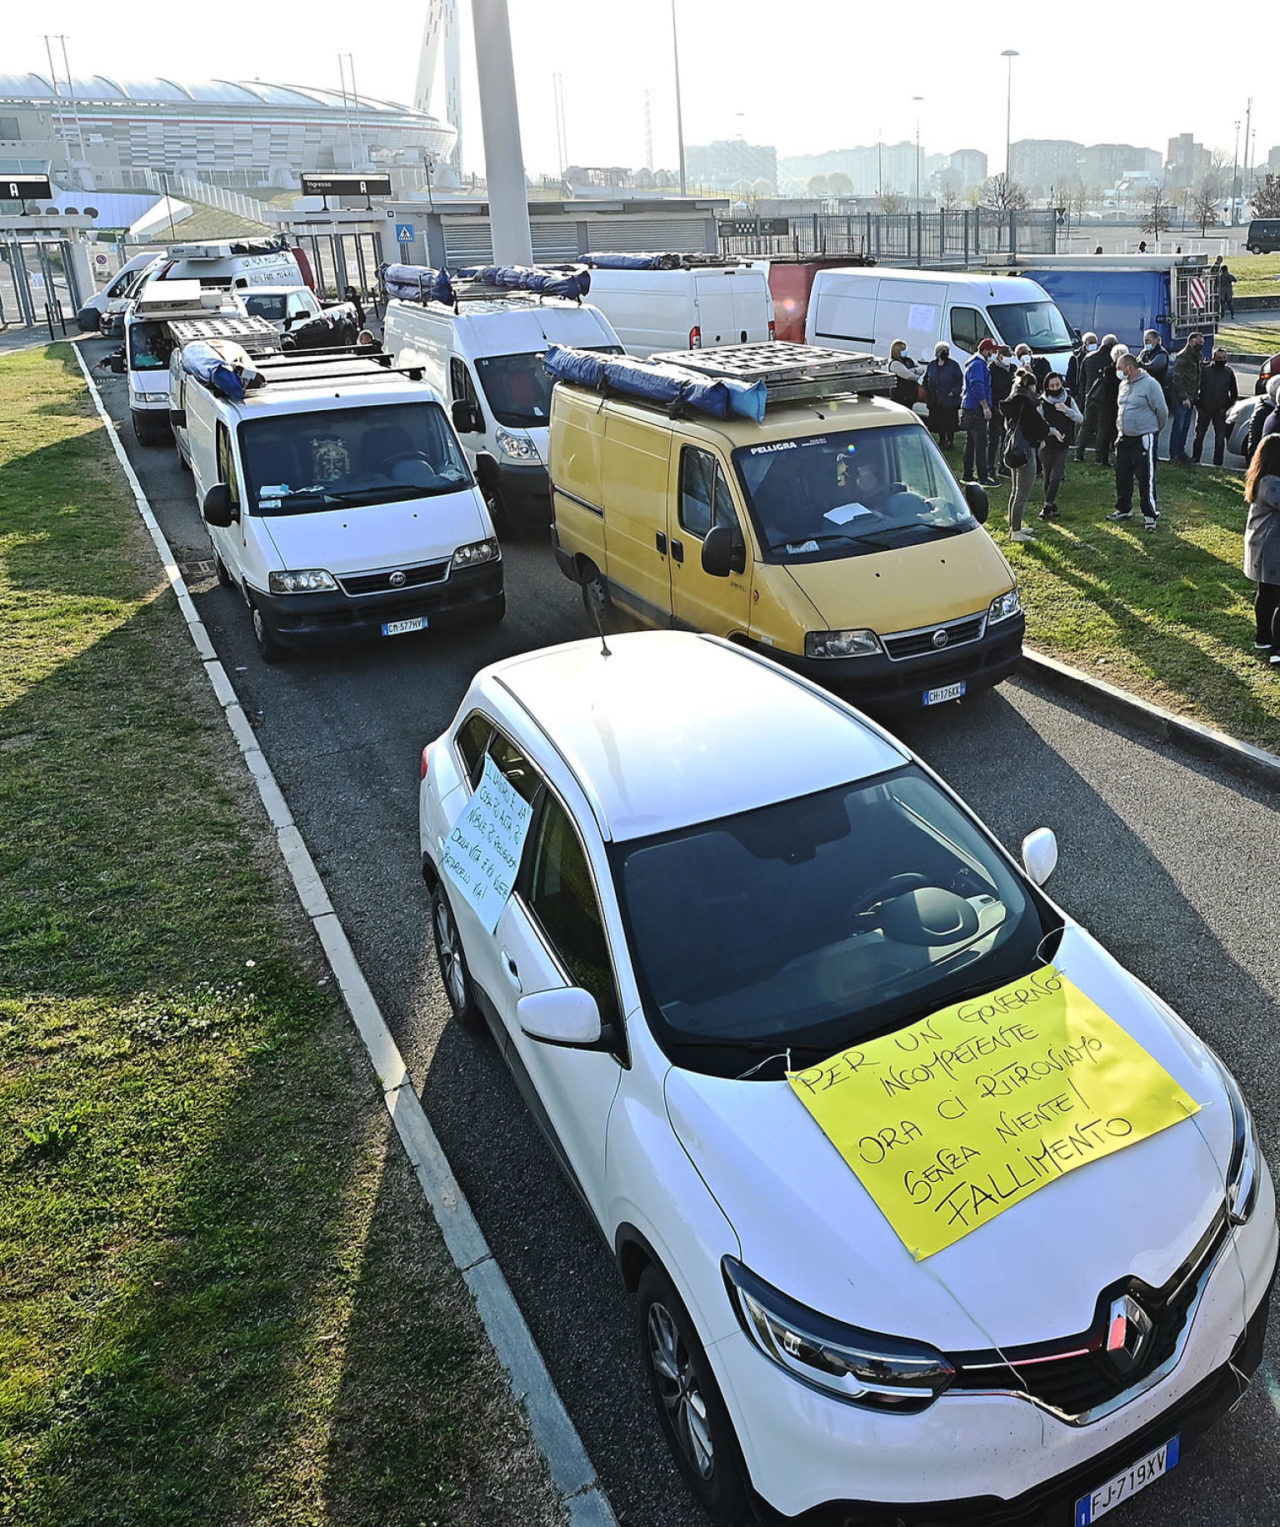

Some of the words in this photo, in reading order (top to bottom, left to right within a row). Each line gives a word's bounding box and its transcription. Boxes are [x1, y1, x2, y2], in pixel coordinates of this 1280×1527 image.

[9, 183, 19, 197] A
[360, 181, 367, 194] A
[750, 441, 798, 455] PELLIGRA
[795, 1051, 881, 1095] PER
[894, 1019, 943, 1051] UN
[957, 975, 1062, 1025] GOVERNO
[879, 1023, 1039, 1097] INCOMPETENTE
[858, 1120, 923, 1165] ORA
[937, 1089, 968, 1120] CI
[974, 1035, 1103, 1099] RITROVIAMO
[904, 1145, 982, 1205] SENZA
[934, 1117, 1133, 1227] FALLIMENTO
